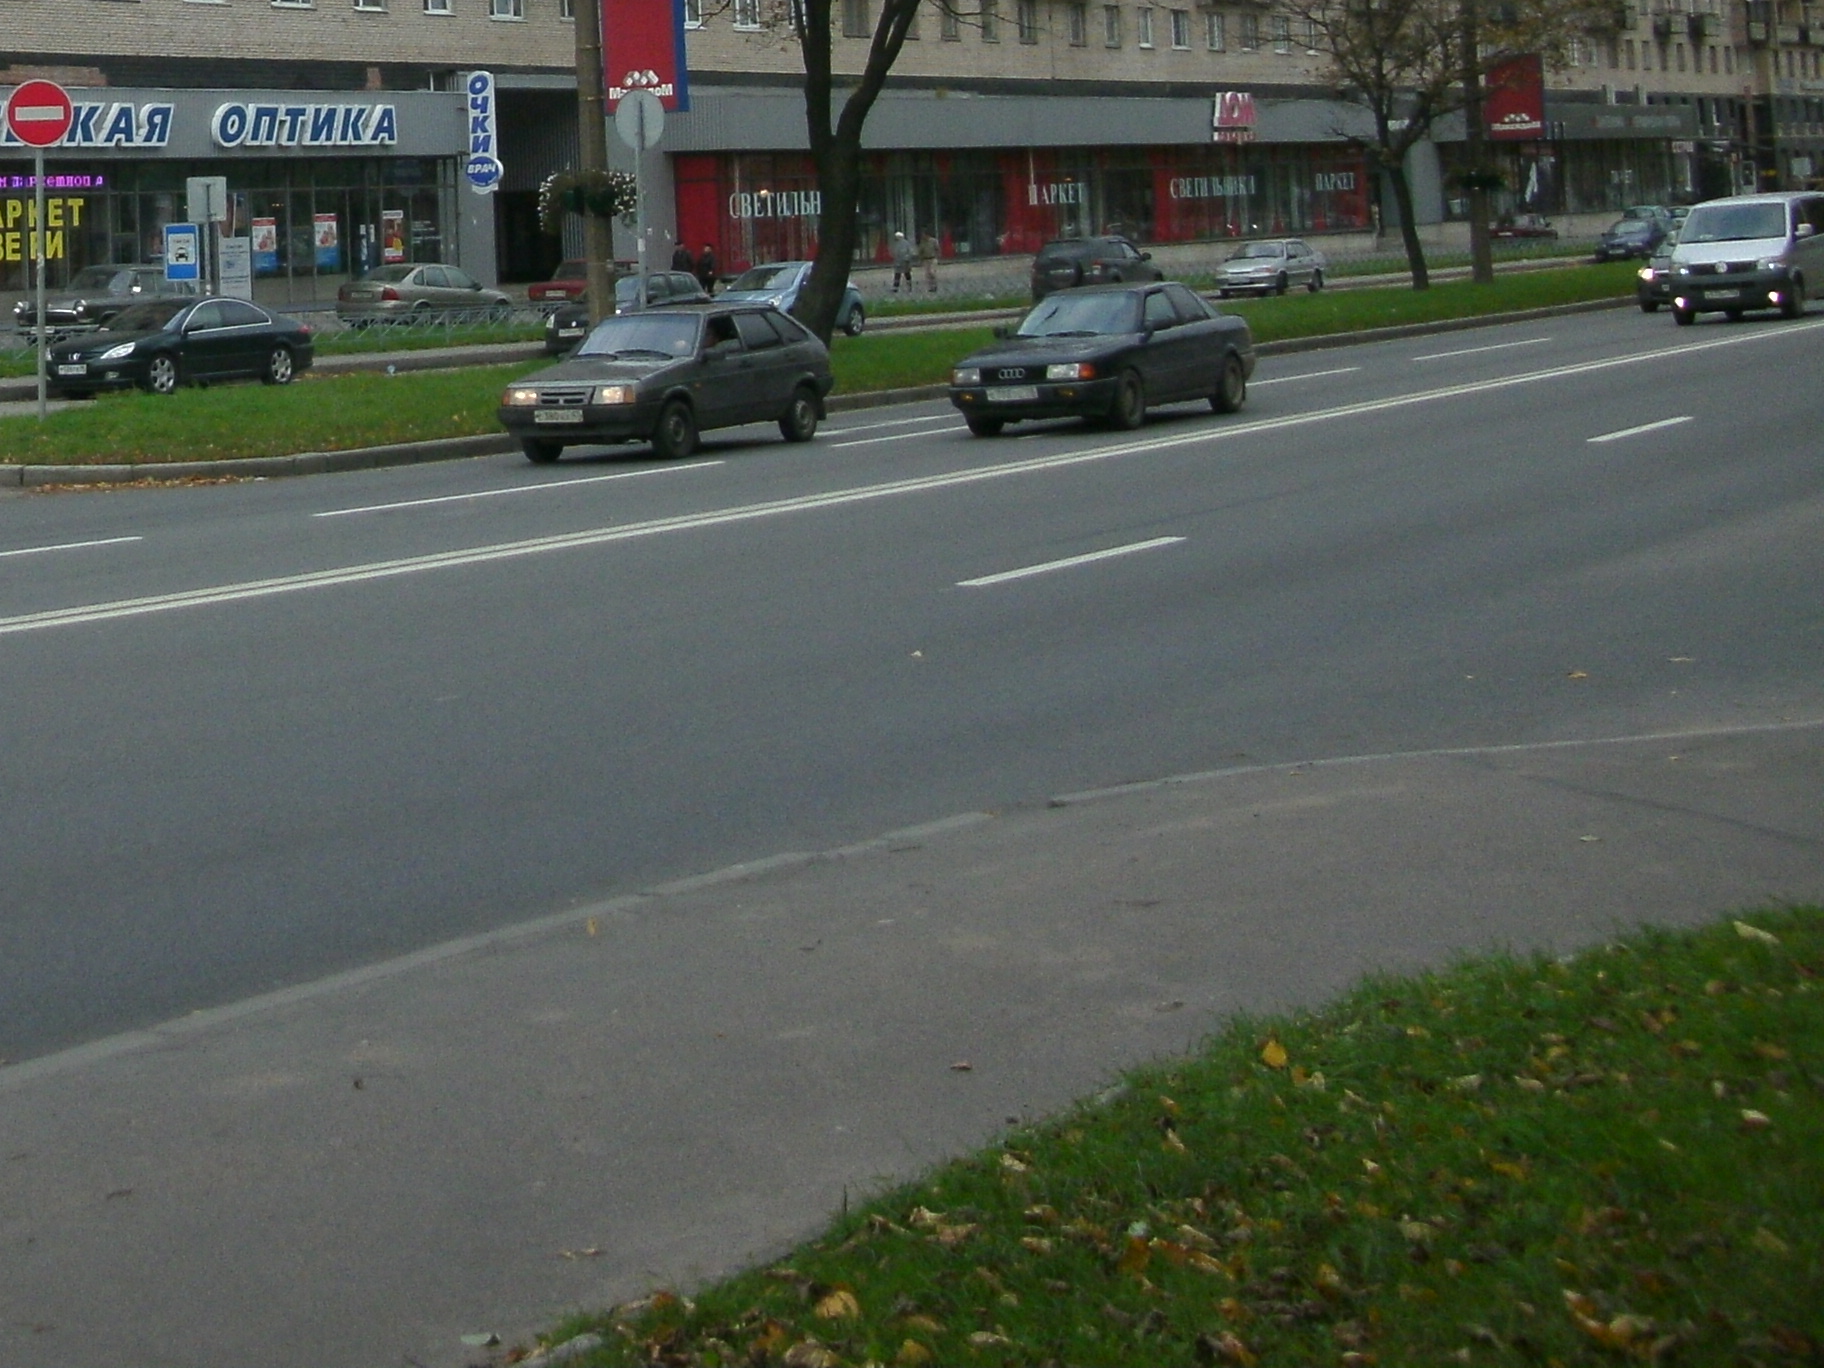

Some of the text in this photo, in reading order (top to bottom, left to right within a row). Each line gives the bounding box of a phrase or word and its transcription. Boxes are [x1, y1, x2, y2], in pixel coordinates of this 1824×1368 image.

[212, 102, 398, 147] ОПТИКА
[468, 74, 490, 154] ОЧКИ
[466, 164, 496, 174] ВРАЧ
[1028, 181, 1085, 206] ПАРКЕТ
